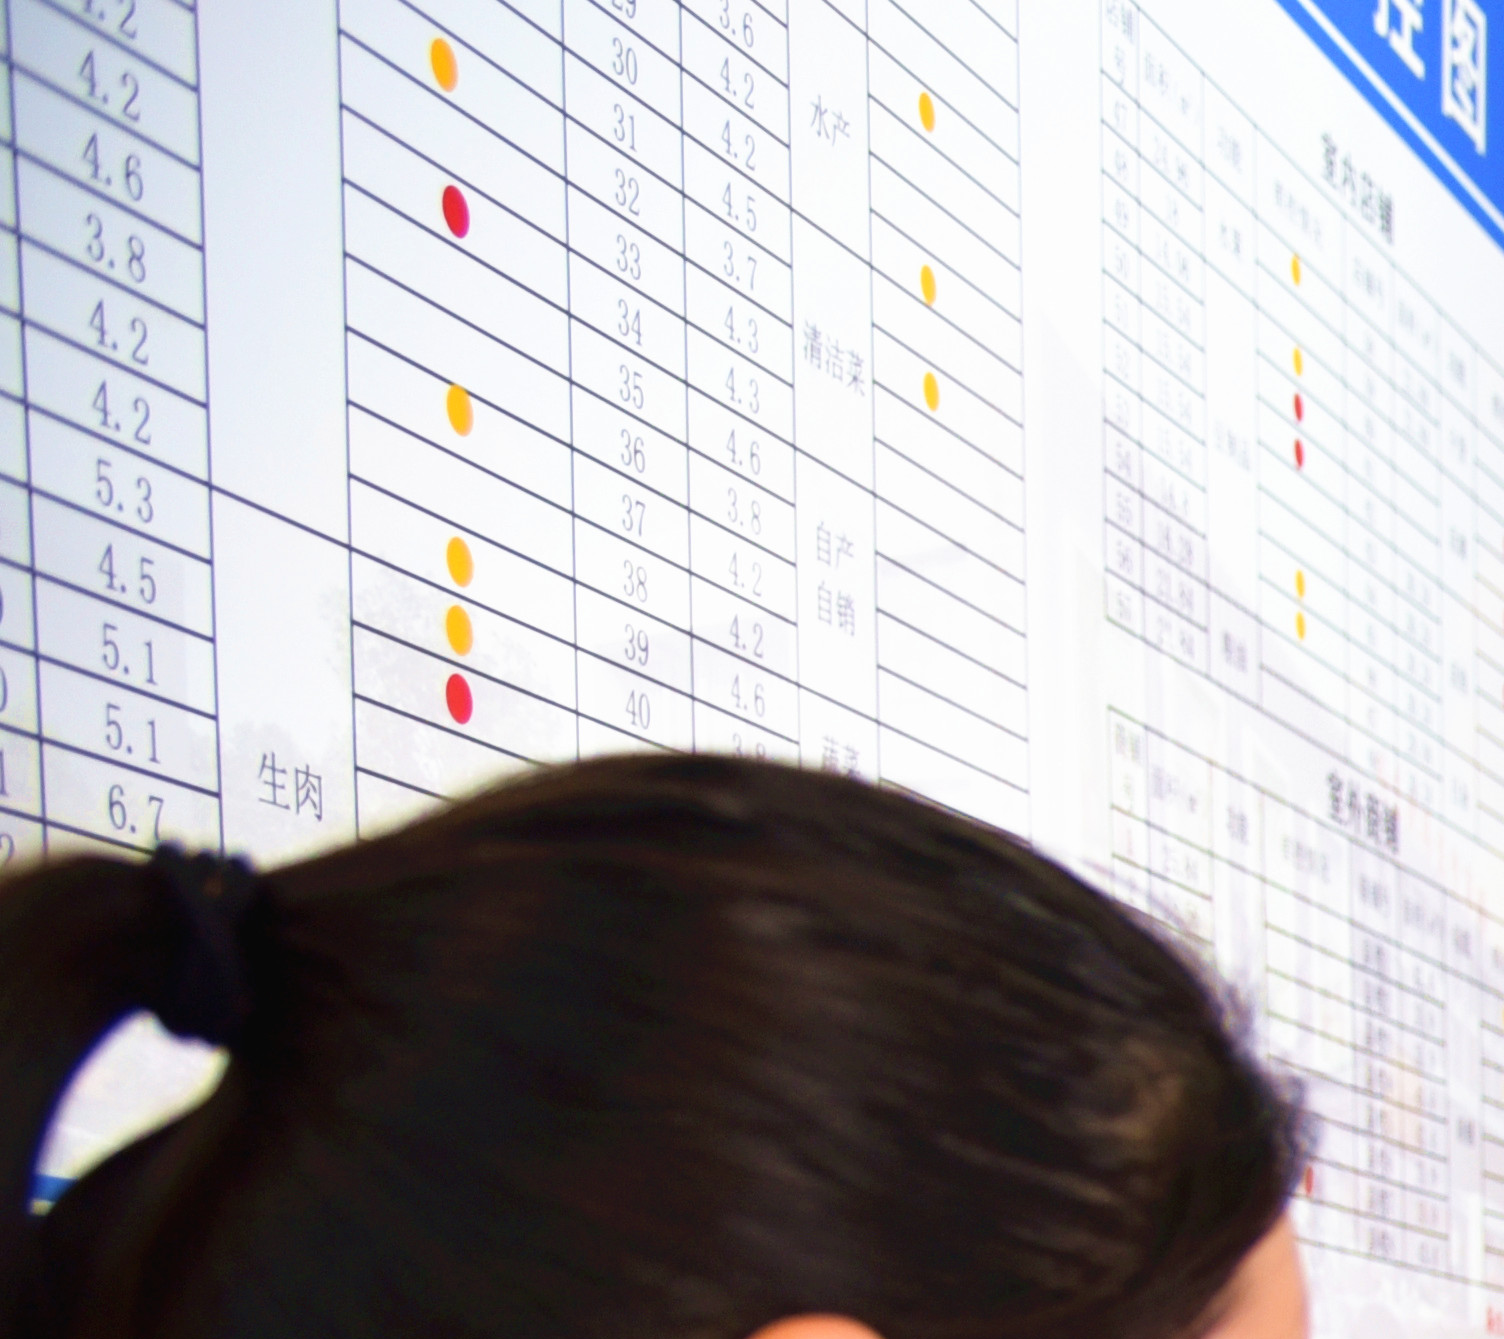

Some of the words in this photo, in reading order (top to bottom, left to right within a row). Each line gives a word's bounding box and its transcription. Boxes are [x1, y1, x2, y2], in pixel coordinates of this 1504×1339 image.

[79, 50, 141, 122] 4.2
[612, 37, 637, 85] 30
[720, 57, 754, 109] 4.2
[614, 103, 637, 152] 31
[721, 120, 755, 171] 4.2
[810, 94, 851, 147] 水产
[83, 132, 144, 201] 4.6
[615, 168, 640, 216] 32
[722, 182, 757, 232] 4.5
[86, 213, 146, 283] 3.8
[616, 234, 641, 280] 33
[723, 240, 757, 290] 3.7
[90, 300, 149, 366] 4.2
[618, 299, 642, 346] 34
[725, 306, 758, 354] 4.3
[619, 364, 644, 409] 35
[725, 367, 760, 414] 4.3
[92, 380, 151, 445] 4.2
[620, 429, 646, 473] 36
[726, 429, 761, 475] 4.6
[96, 459, 154, 523] 5.3
[622, 494, 646, 537] 37
[816, 520, 856, 570] 自产
[99, 543, 156, 604] 4.5
[623, 560, 648, 602] 38
[103, 623, 158, 685] 5.1
[625, 624, 649, 666] 39
[730, 615, 764, 659] 4.2
[626, 690, 650, 729] 40
[731, 674, 765, 718] 4.6
[106, 703, 160, 764] 5.1
[257, 751, 324, 821] 生肉
[109, 785, 164, 840] 6.7
